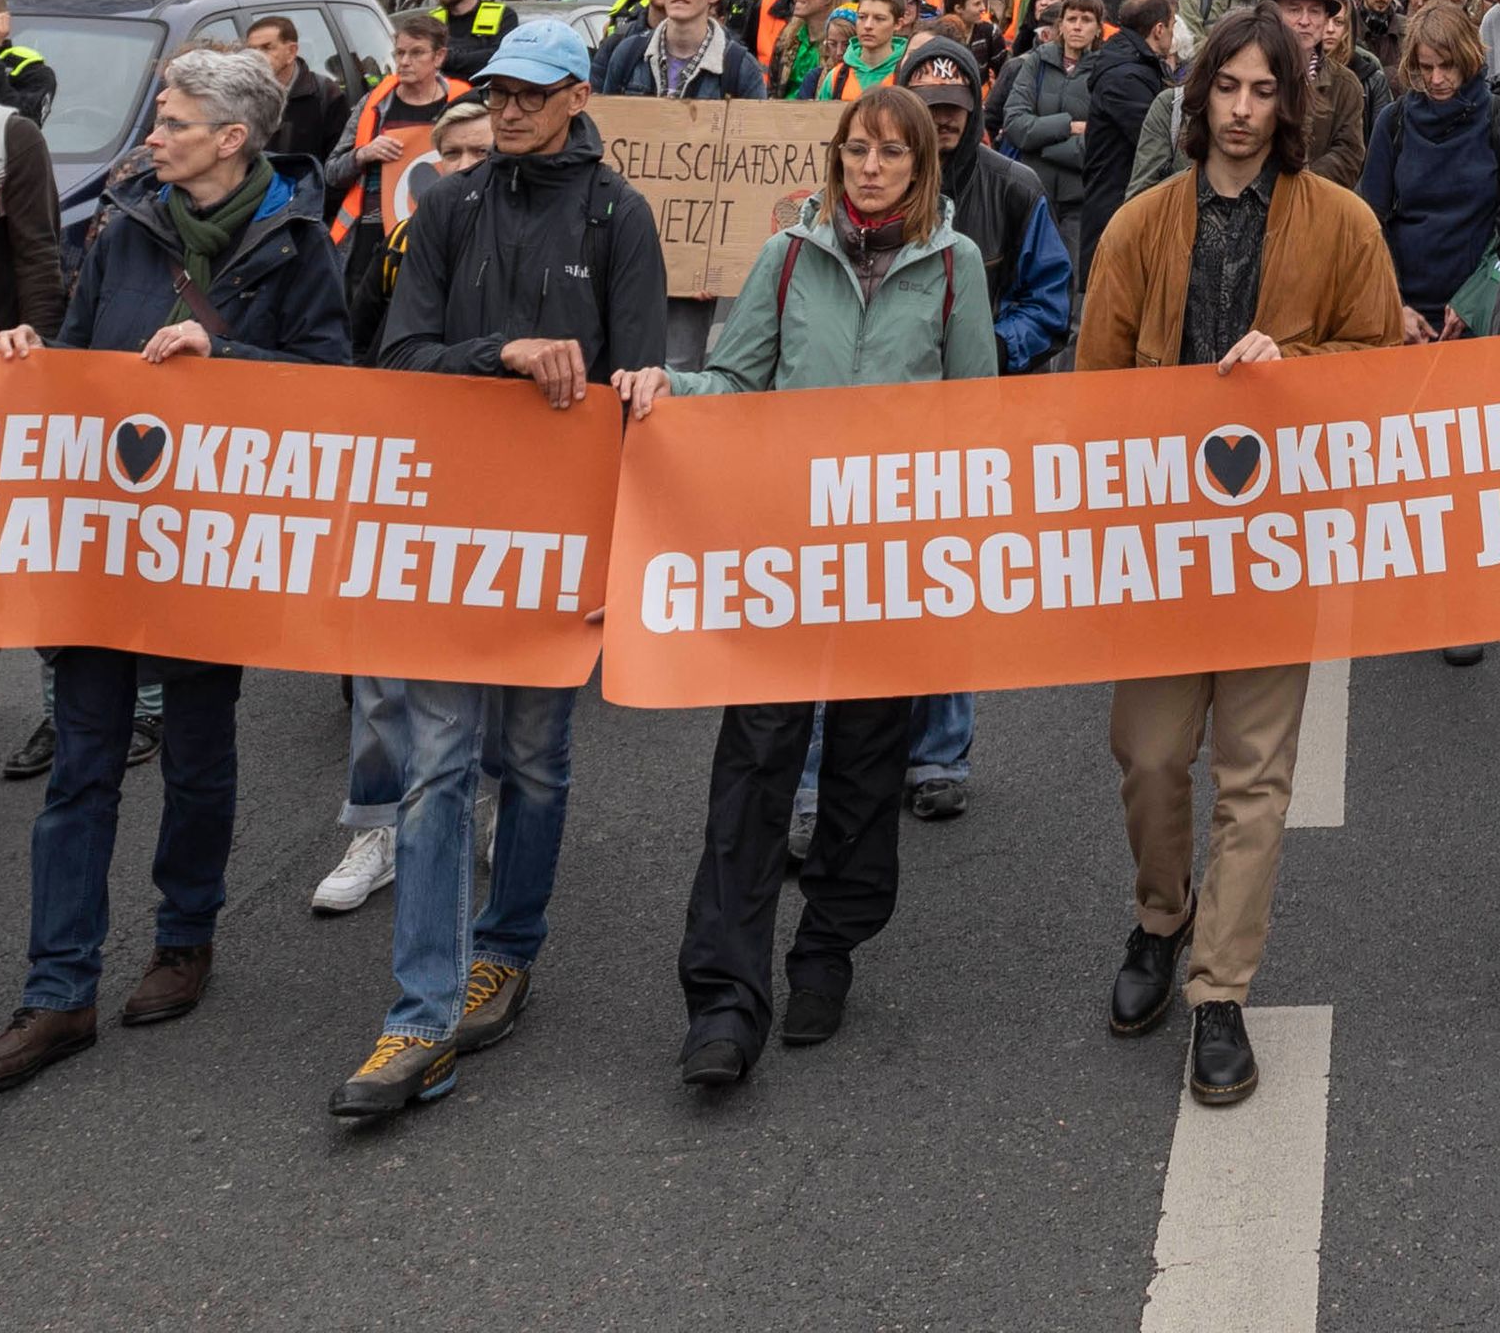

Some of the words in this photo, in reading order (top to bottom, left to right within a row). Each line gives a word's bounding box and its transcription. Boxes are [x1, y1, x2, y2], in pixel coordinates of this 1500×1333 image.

[809, 447, 1012, 527] MEHR
[339, 521, 588, 612] JETZT!
[640, 494, 1453, 635] GESELLSCHAFTSRAT
